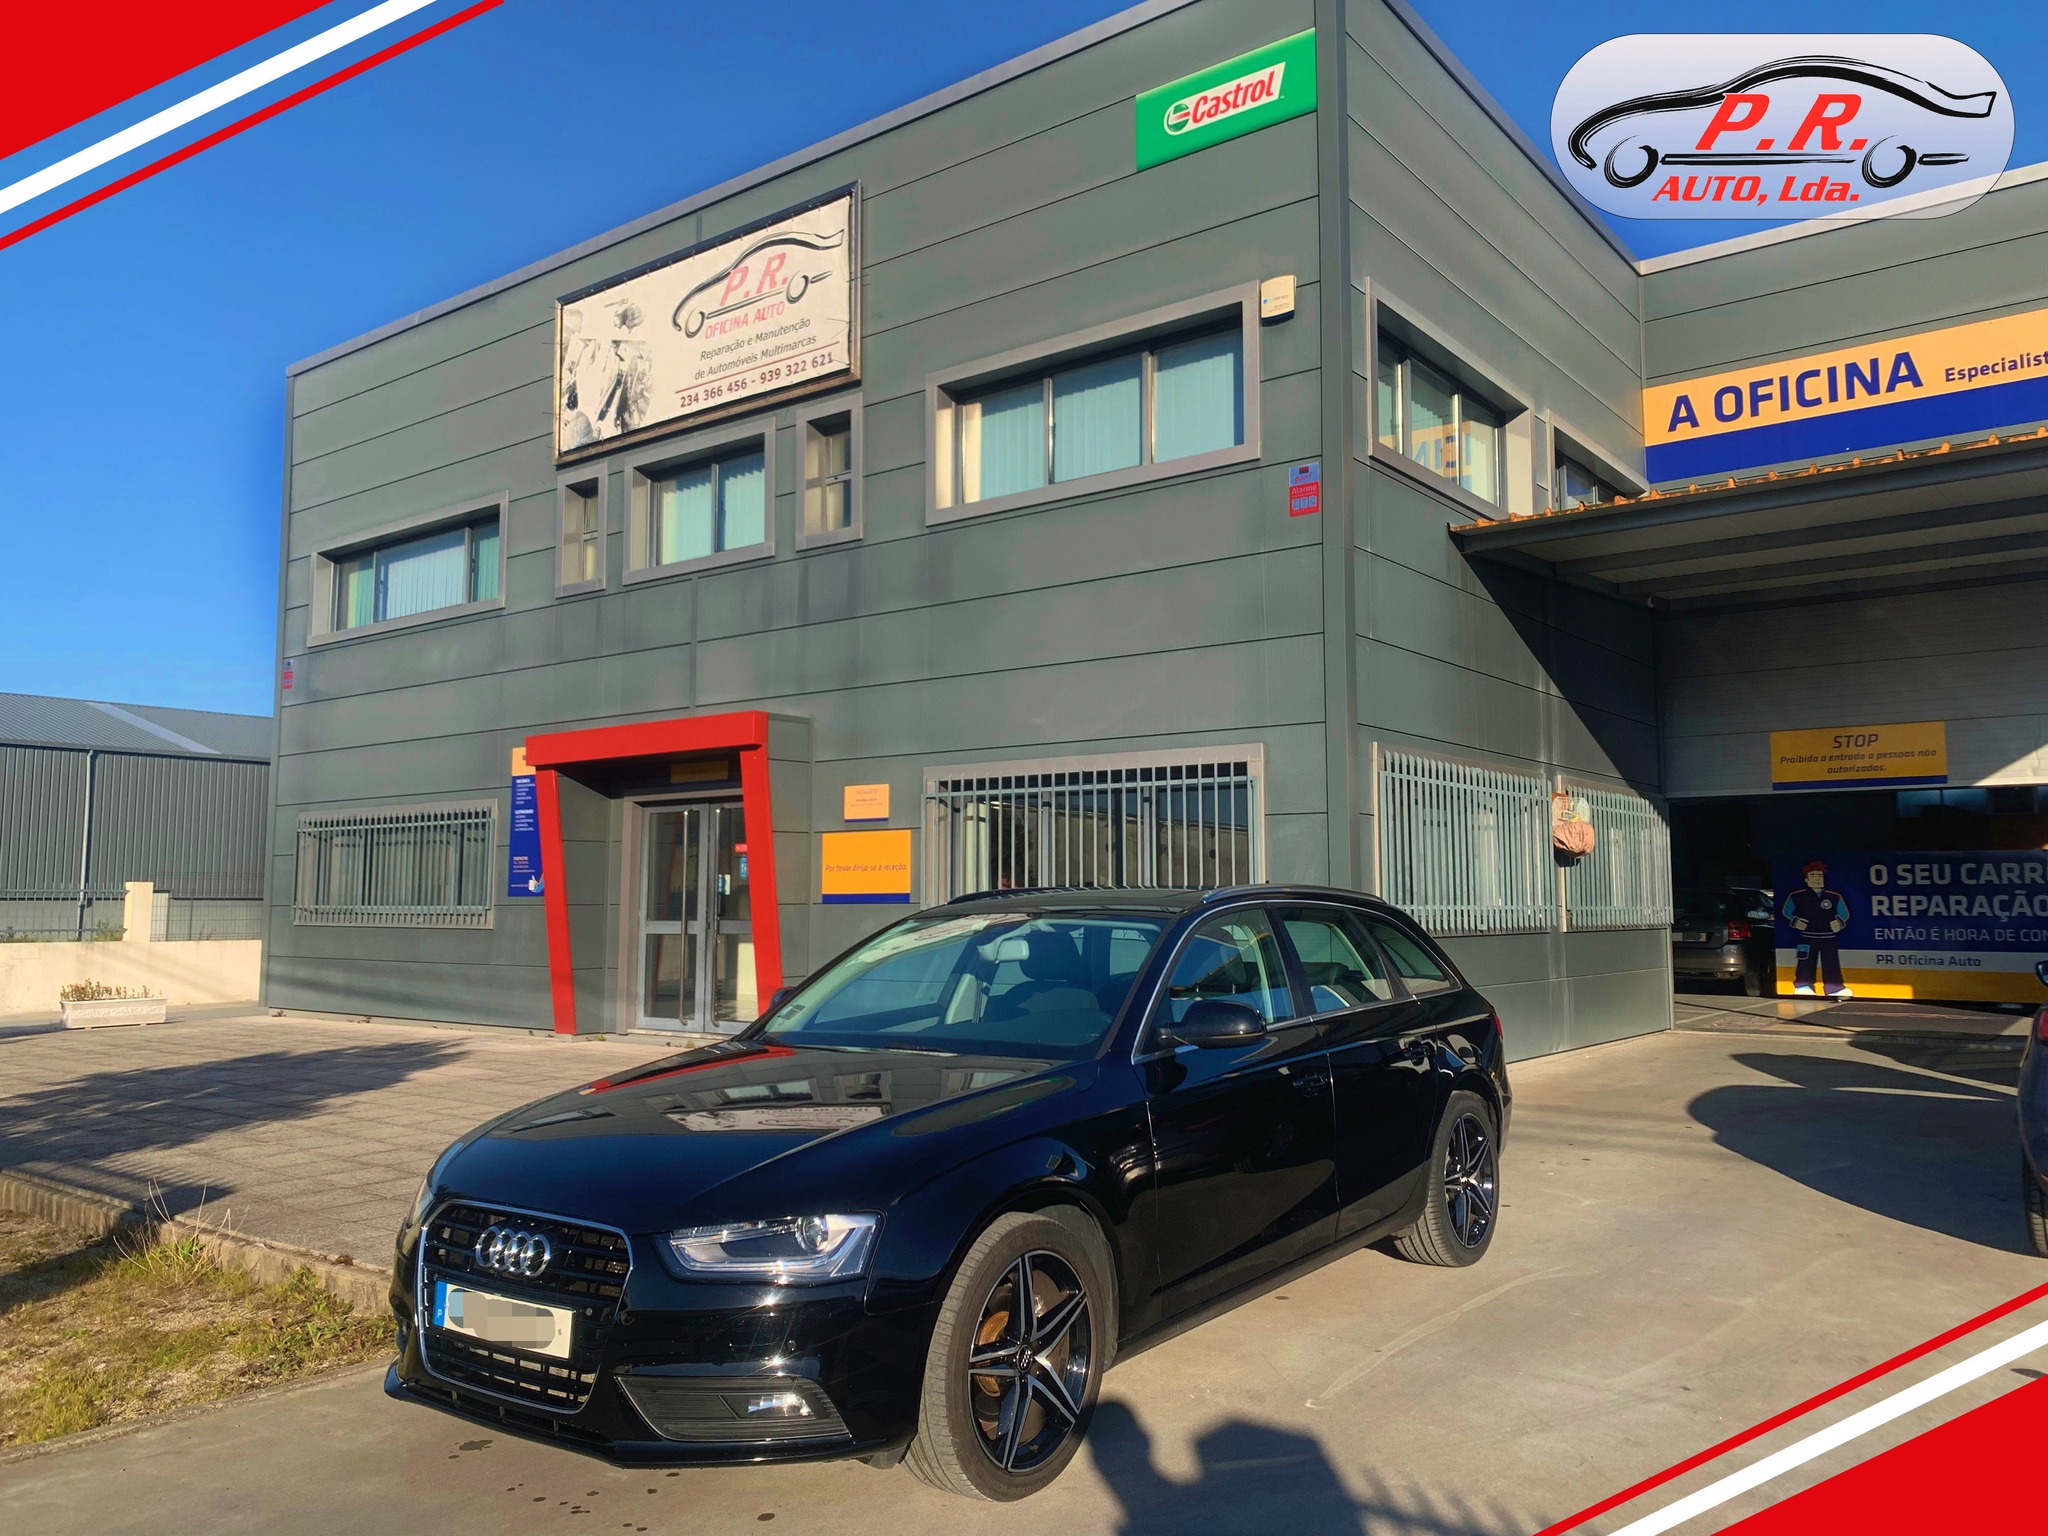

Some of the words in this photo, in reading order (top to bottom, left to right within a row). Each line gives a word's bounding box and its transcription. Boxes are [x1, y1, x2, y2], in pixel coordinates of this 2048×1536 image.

[1192, 70, 1275, 124] Castrol
[704, 312, 749, 339] OFICINA
[753, 301, 785, 323] AUTO
[700, 339, 745, 361] Reparação
[747, 337, 753, 346] e
[755, 318, 811, 343] Manutenção
[695, 369, 705, 380] de
[706, 353, 758, 376] Automóveis
[760, 335, 817, 360] Multimarcas
[680, 392, 700, 408] 234
[703, 385, 723, 401] 366
[726, 377, 748, 394] 456
[760, 368, 781, 385] 939
[785, 360, 807, 377] 322
[811, 352, 834, 369] 621
[1667, 394, 1700, 433] A
[1714, 351, 1924, 423] OFICINA
[1832, 733, 1879, 749] STOP
[1876, 751, 1915, 761] pessoas
[1827, 764, 1887, 774] autorizadas.
[1869, 864, 1889, 886] O
[1896, 863, 1952, 886] SEU
[1960, 862, 2048, 885] CARR
[1871, 889, 2048, 923] REPARAÇÃO
[1874, 926, 1927, 941] ENTÃO
[1931, 926, 1940, 941] É
[1944, 928, 1991, 941] HORA
[1994, 929, 2016, 942] DE
[1876, 954, 1894, 965] PR
[1898, 954, 1945, 966] Oficina
[1949, 956, 1982, 967] Auto
